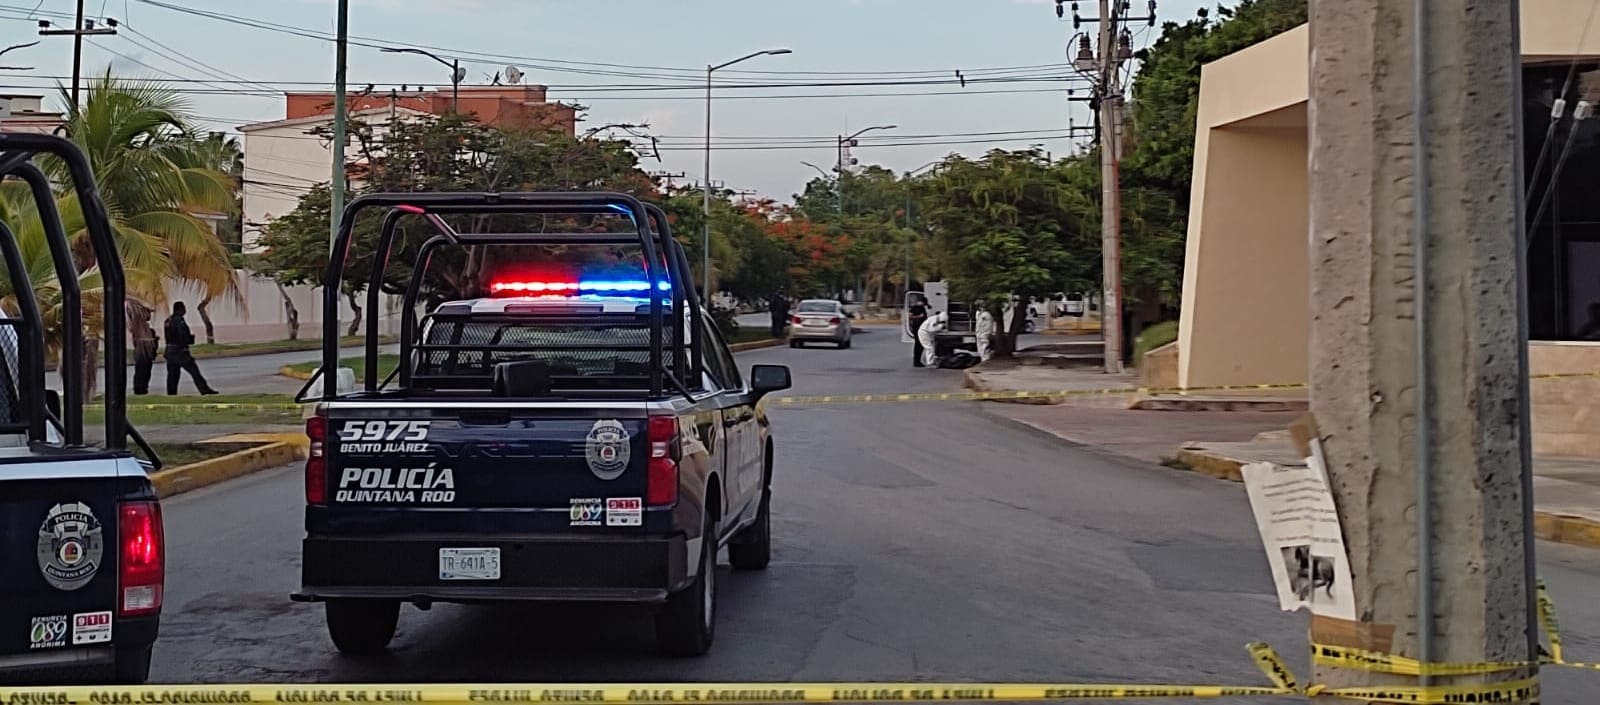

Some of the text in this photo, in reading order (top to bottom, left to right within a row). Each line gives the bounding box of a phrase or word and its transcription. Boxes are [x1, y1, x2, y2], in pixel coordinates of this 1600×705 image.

[340, 420, 431, 441] 5975
[340, 441, 429, 453] BENITO JUÁREZ
[339, 462, 454, 489] POLICÍA
[336, 490, 456, 502] QUINTANA ROO
[78, 615, 108, 626] 911
[31, 621, 68, 643] 089
